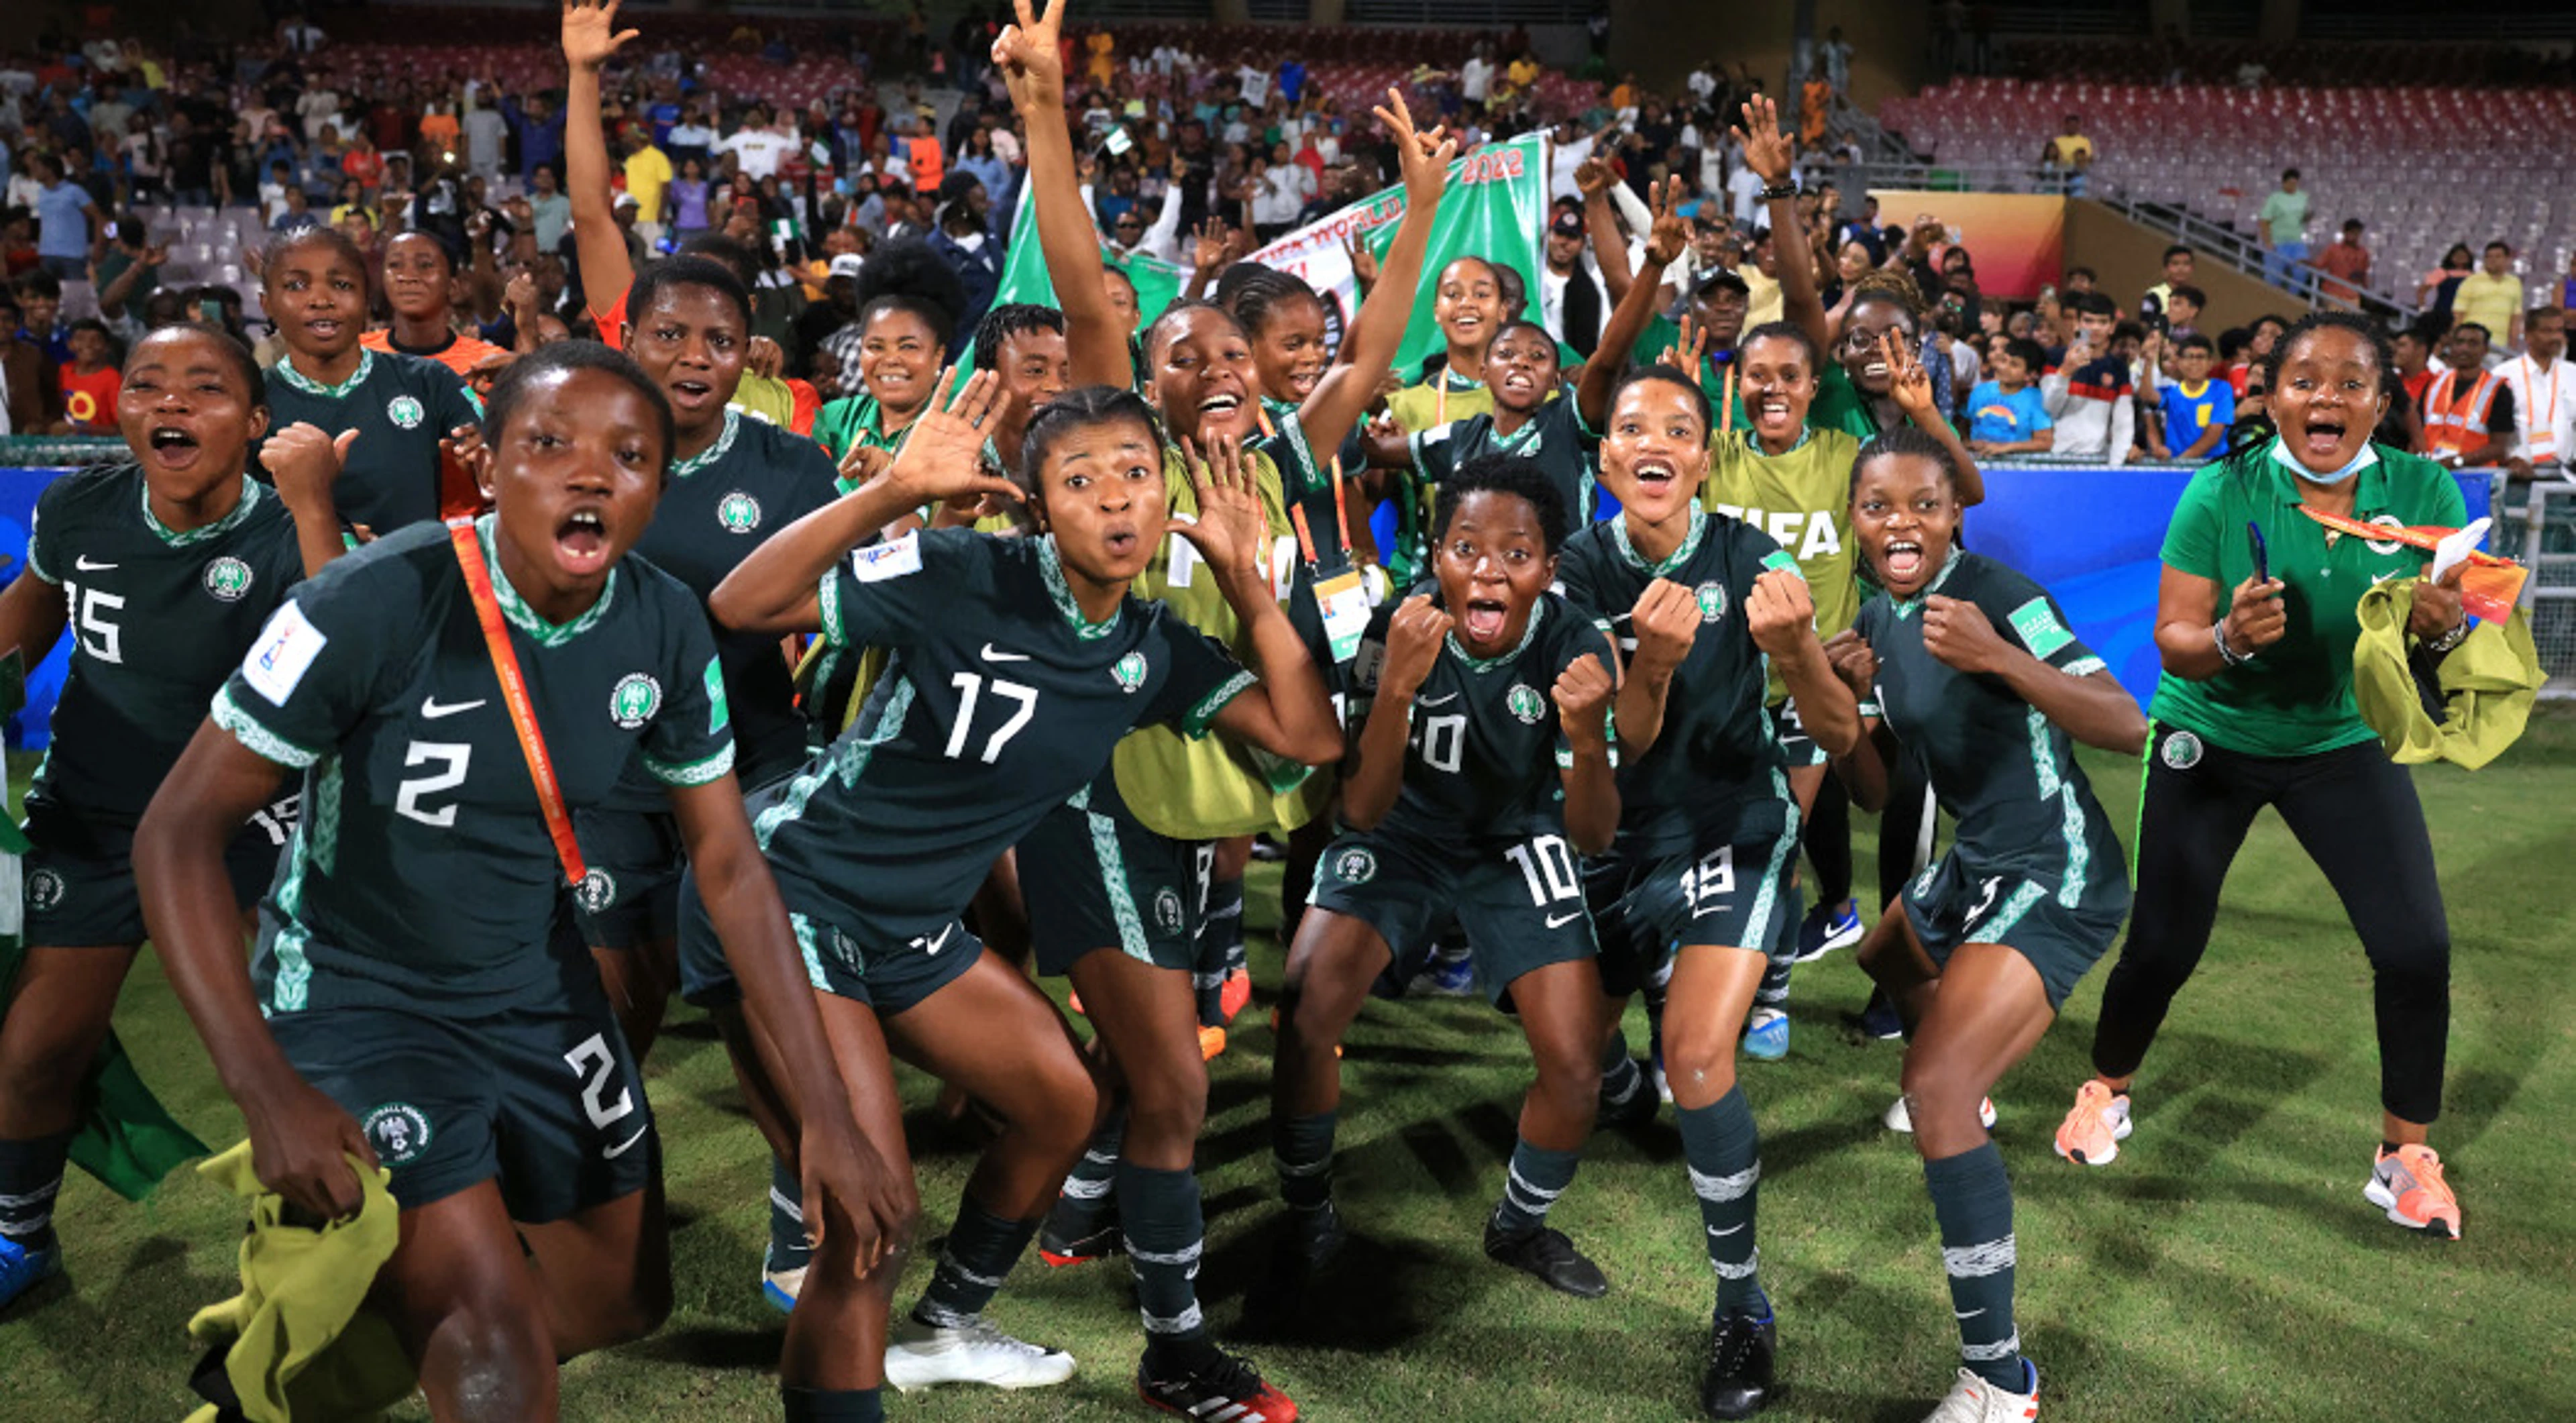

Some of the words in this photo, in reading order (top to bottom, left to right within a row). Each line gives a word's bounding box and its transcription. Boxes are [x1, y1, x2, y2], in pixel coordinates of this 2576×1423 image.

[1309, 197, 1402, 246] WORLD
[1461, 148, 1523, 184] 2022
[64, 580, 125, 663] 15
[945, 672, 1038, 763] 17
[1411, 714, 1466, 773] 0
[396, 740, 472, 827] 2
[1504, 835, 1580, 907] 10
[564, 1032, 634, 1130] 2
